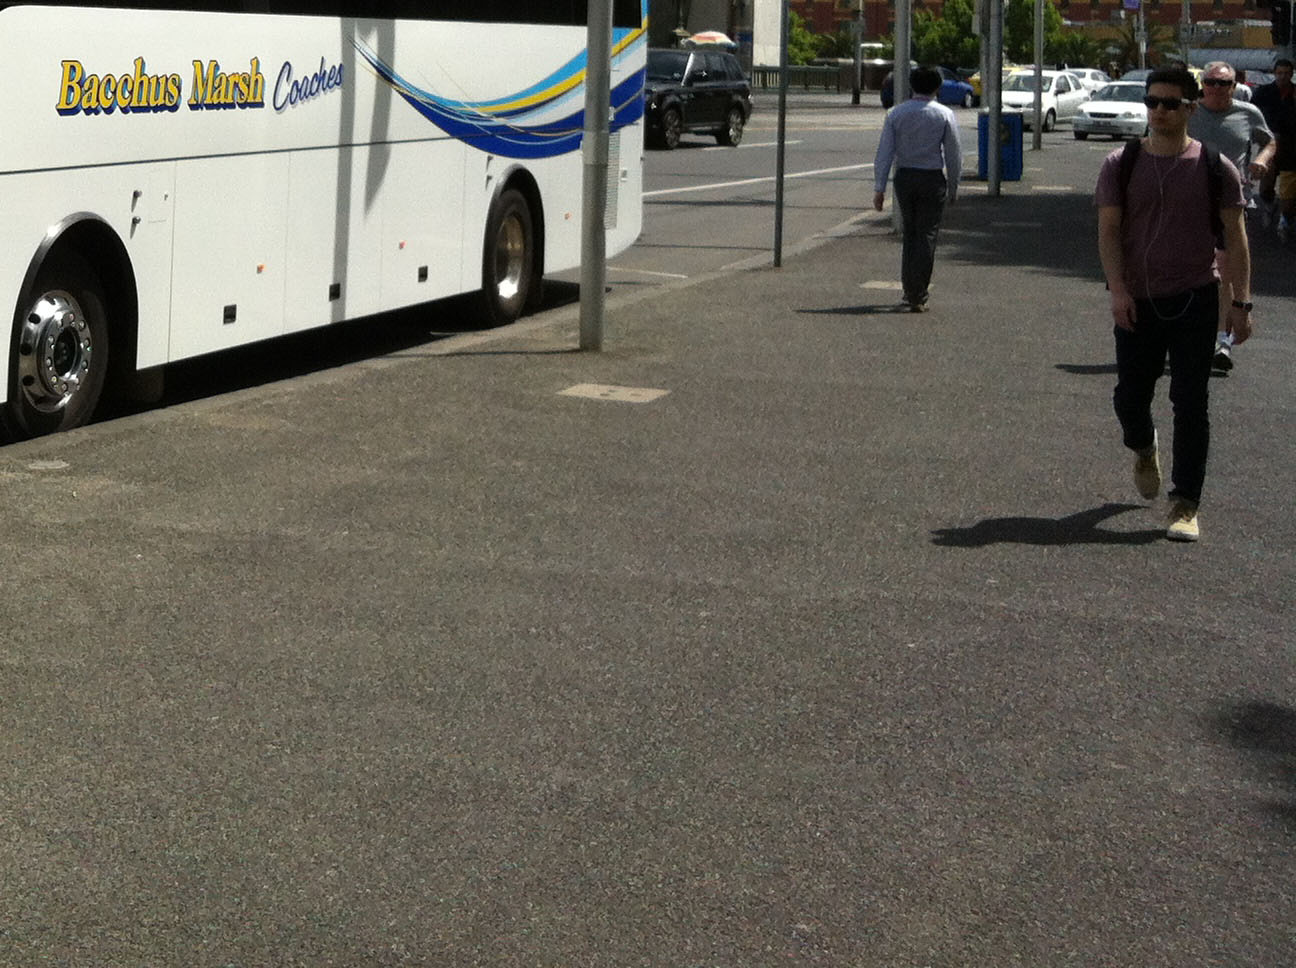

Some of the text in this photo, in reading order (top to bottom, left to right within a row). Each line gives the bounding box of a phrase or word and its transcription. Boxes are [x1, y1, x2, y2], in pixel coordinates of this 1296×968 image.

[55, 56, 344, 116] Bacchus Marsh Coaches
